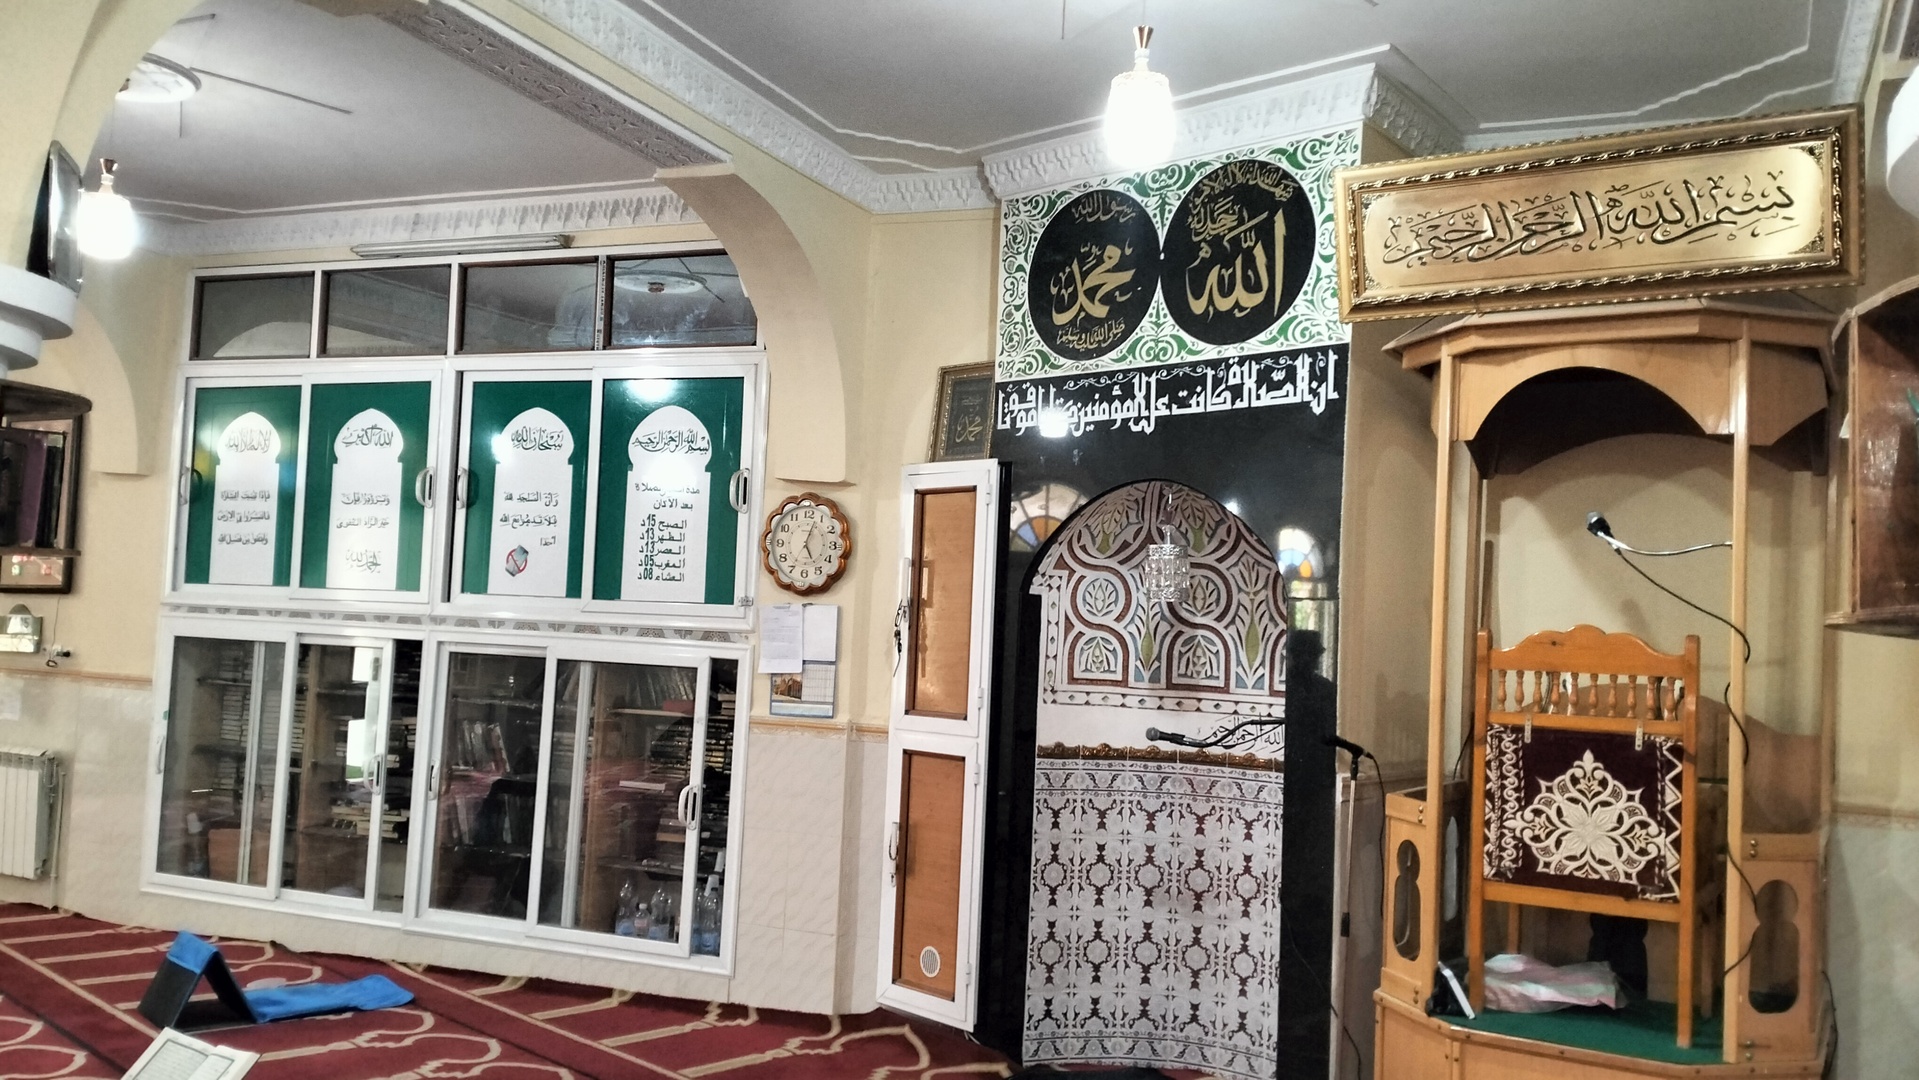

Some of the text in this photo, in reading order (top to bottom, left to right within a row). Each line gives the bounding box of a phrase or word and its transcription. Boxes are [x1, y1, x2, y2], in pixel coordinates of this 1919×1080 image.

[1072, 190, 1098, 224] الله
[1381, 178, 1796, 266] بسم الله الرحمن الرحيم
[1186, 208, 1287, 317] الله
[1051, 244, 1136, 325] محمد
[1101, 317, 1125, 347] صلى
[1172, 366, 1232, 415] كانت
[684, 436, 710, 455] بسم
[680, 502, 693, 511] بعد
[790, 513, 798, 521] 11
[804, 509, 815, 519] 12
[657, 519, 687, 532] الصبح
[780, 523, 790, 533] 10
[826, 525, 836, 534] 2
[655, 531, 685, 544] الظهر
[776, 538, 785, 548] 9
[828, 540, 837, 550] 3
[655, 545, 685, 557] العصر
[778, 553, 788, 562] 8
[824, 554, 832, 563] 4
[655, 558, 685, 571] المغرب
[787, 565, 796, 574] 7
[800, 568, 809, 579] 6
[814, 566, 823, 575] 5
[654, 572, 685, 582] العشاء
